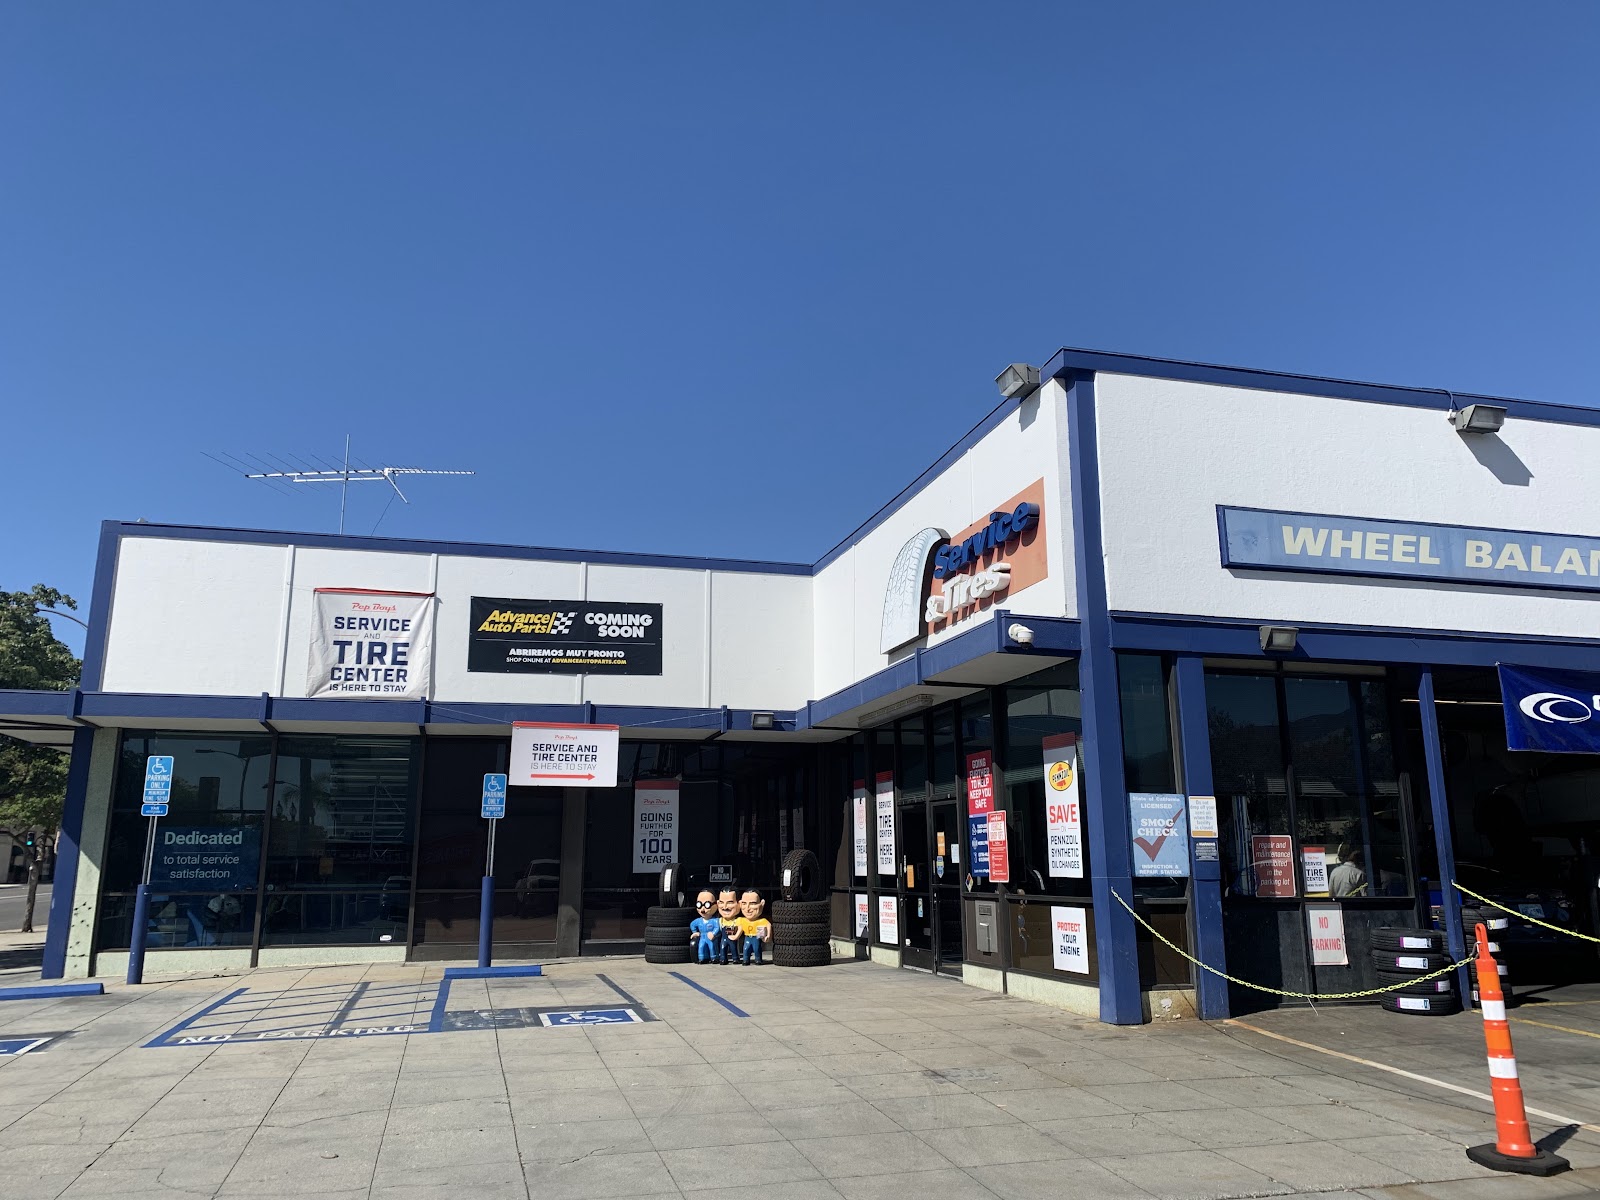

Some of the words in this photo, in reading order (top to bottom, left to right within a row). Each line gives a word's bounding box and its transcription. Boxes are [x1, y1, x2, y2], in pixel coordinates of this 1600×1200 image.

[934, 502, 1039, 579] Service
[1281, 525, 1440, 564] WHEEL
[925, 595, 947, 622] &
[942, 563, 1010, 613] Tires
[352, 602, 371, 612] Pep
[373, 603, 396, 613] Boys
[486, 610, 550, 624] Advance
[584, 613, 653, 626] COMING
[334, 616, 411, 631] SERVICE
[478, 621, 513, 632] Auto
[512, 622, 548, 634] Parts
[598, 626, 645, 638] SOON
[333, 640, 410, 666] TIRE
[509, 648, 564, 657] ABRIREMOS
[588, 650, 625, 658] PRONTO
[330, 667, 408, 682] CENTER
[342, 684, 366, 692] HERE
[370, 684, 381, 692] TO
[532, 744, 575, 752] SERVICE
[576, 745, 598, 753] AND
[532, 753, 555, 762] TIRE
[558, 754, 598, 762] CENTER
[972, 758, 986, 768] GOING
[970, 767, 990, 779] FURTHER
[1052, 767, 1070, 782] PENNZOIL
[970, 780, 977, 789] TO
[978, 778, 990, 788] HELP
[970, 790, 982, 799] KEEP
[982, 788, 992, 798] YOU
[974, 798, 987, 809] SAFE
[640, 813, 673, 822] GOING
[1050, 804, 1077, 824] SAVE
[879, 814, 892, 828] TIRE
[1140, 818, 1174, 827] SMOG
[164, 830, 243, 845] Dedicated
[1137, 828, 1179, 836] CHECK
[1050, 834, 1078, 845] PENNZOIL
[640, 838, 672, 854] 100
[1258, 842, 1275, 850] repair
[1051, 847, 1080, 858] SYNTHETIC
[1256, 850, 1290, 858] maintenance
[163, 855, 174, 864] to
[177, 854, 200, 864] total
[202, 856, 240, 864] service
[1059, 860, 1080, 869] CHANGES
[169, 868, 230, 878] satisfaction
[1260, 878, 1282, 887] parking
[1057, 921, 1081, 933] PROTECT
[1318, 917, 1328, 928] NO
[1062, 934, 1076, 944] YOUR
[1311, 938, 1341, 950] PARKING
[1060, 945, 1080, 956] ENGINE
[178, 1034, 232, 1044] NO
[257, 1026, 414, 1040] PARKING
